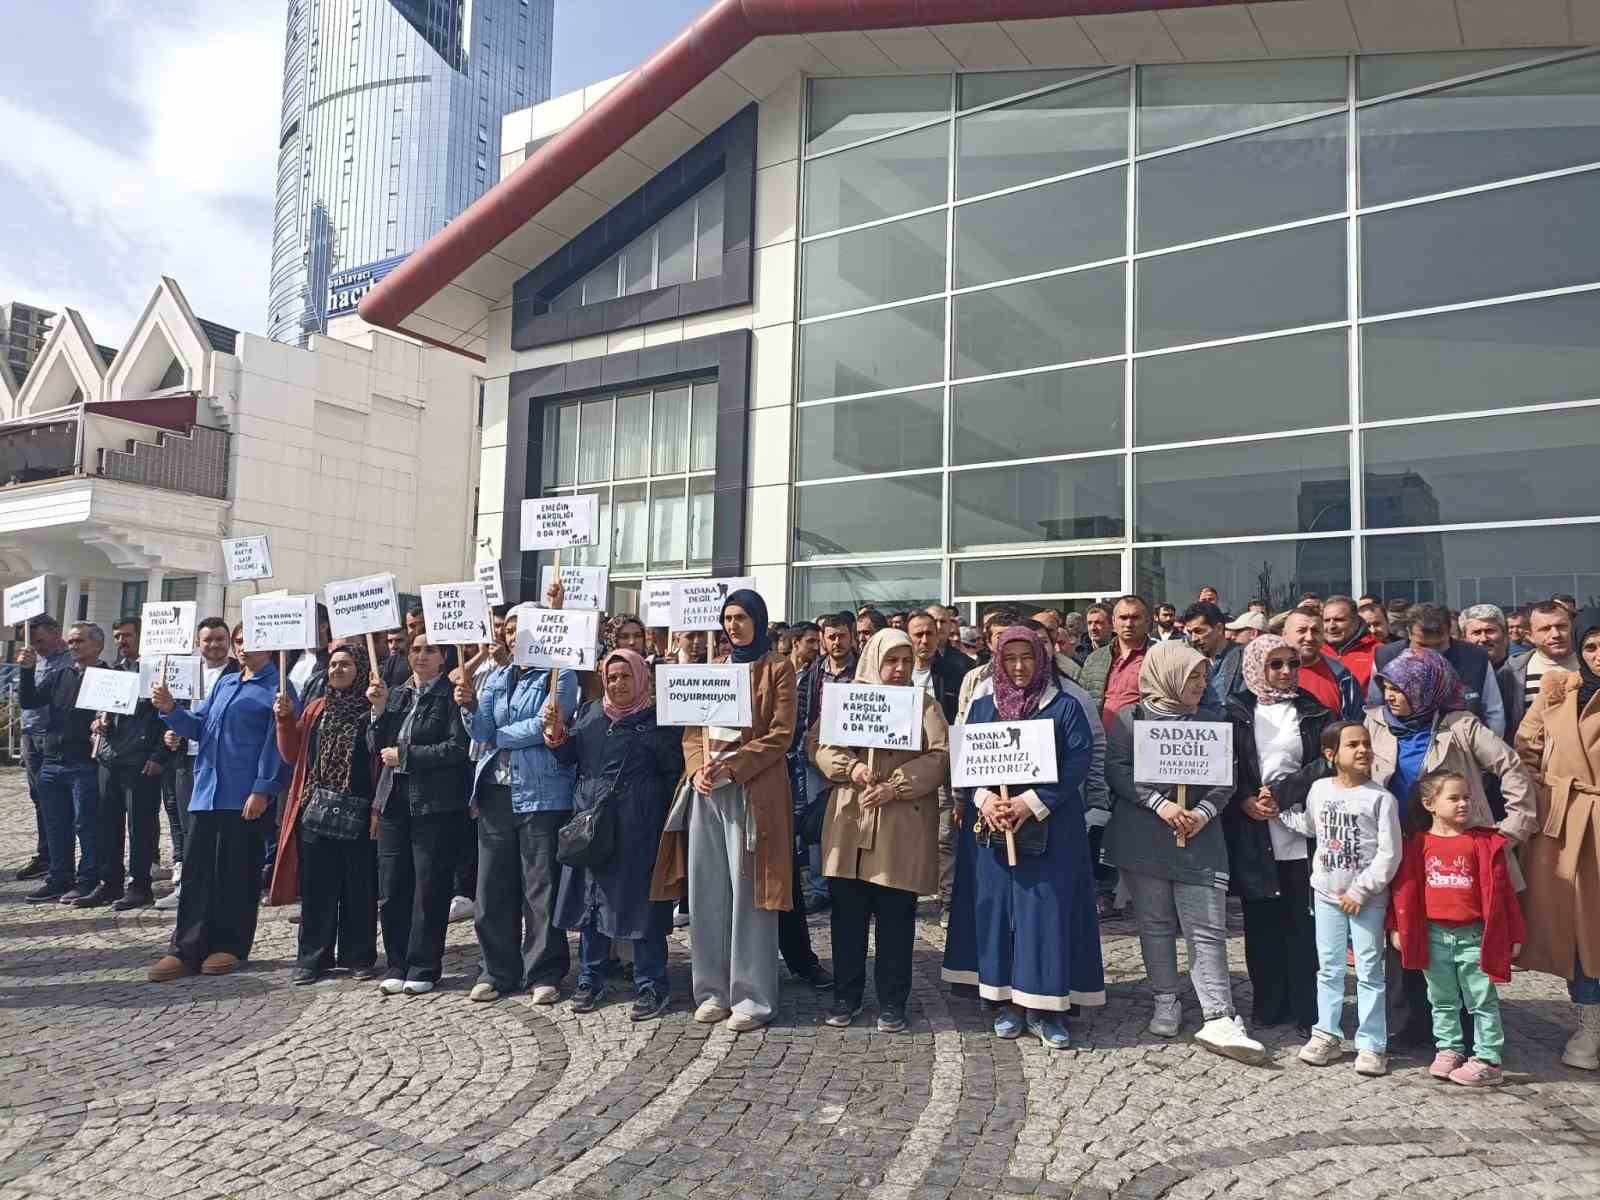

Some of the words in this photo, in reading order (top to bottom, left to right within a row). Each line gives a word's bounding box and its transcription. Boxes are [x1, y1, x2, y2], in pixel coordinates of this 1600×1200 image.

[542, 520, 567, 529] EKMEK
[543, 530, 554, 538] DA
[564, 577, 584, 585] AKTIR
[566, 585, 581, 593] ASP
[684, 586, 717, 595] SADAKA
[333, 592, 358, 605] YALAN
[360, 587, 383, 597] KARIN
[438, 590, 460, 599] EMEK
[335, 598, 390, 615] DOYURMUYOR
[436, 600, 466, 609] HAKTIR
[442, 610, 463, 620] GASP
[541, 614, 565, 624] EMEK
[536, 625, 568, 634] HAKTIR
[540, 635, 563, 645] GASP
[668, 678, 700, 688] YALAN
[702, 679, 730, 687] KARIN
[669, 692, 736, 703] DOYURMUYOR
[849, 691, 886, 702] EMEĞİN
[842, 702, 891, 713] KARŞILIĞI
[849, 712, 882, 722] EKMEK
[842, 722, 848, 731] O
[851, 723, 864, 732] DA
[868, 724, 889, 734] YOK!
[966, 731, 1006, 741] SADAKA
[1149, 727, 1218, 741] SADAKA
[972, 740, 1001, 751] DEĞİL
[1159, 741, 1209, 757] DEĞİL
[966, 751, 1029, 765] HAKKIMIZI
[1159, 760, 1209, 768] HAKKIMIZI
[1321, 811, 1360, 828] THINK
[1324, 826, 1361, 841] TWICE
[1344, 840, 1361, 855] BE
[1322, 853, 1361, 870] HAPPY
[1427, 872, 1472, 888] Barbie
